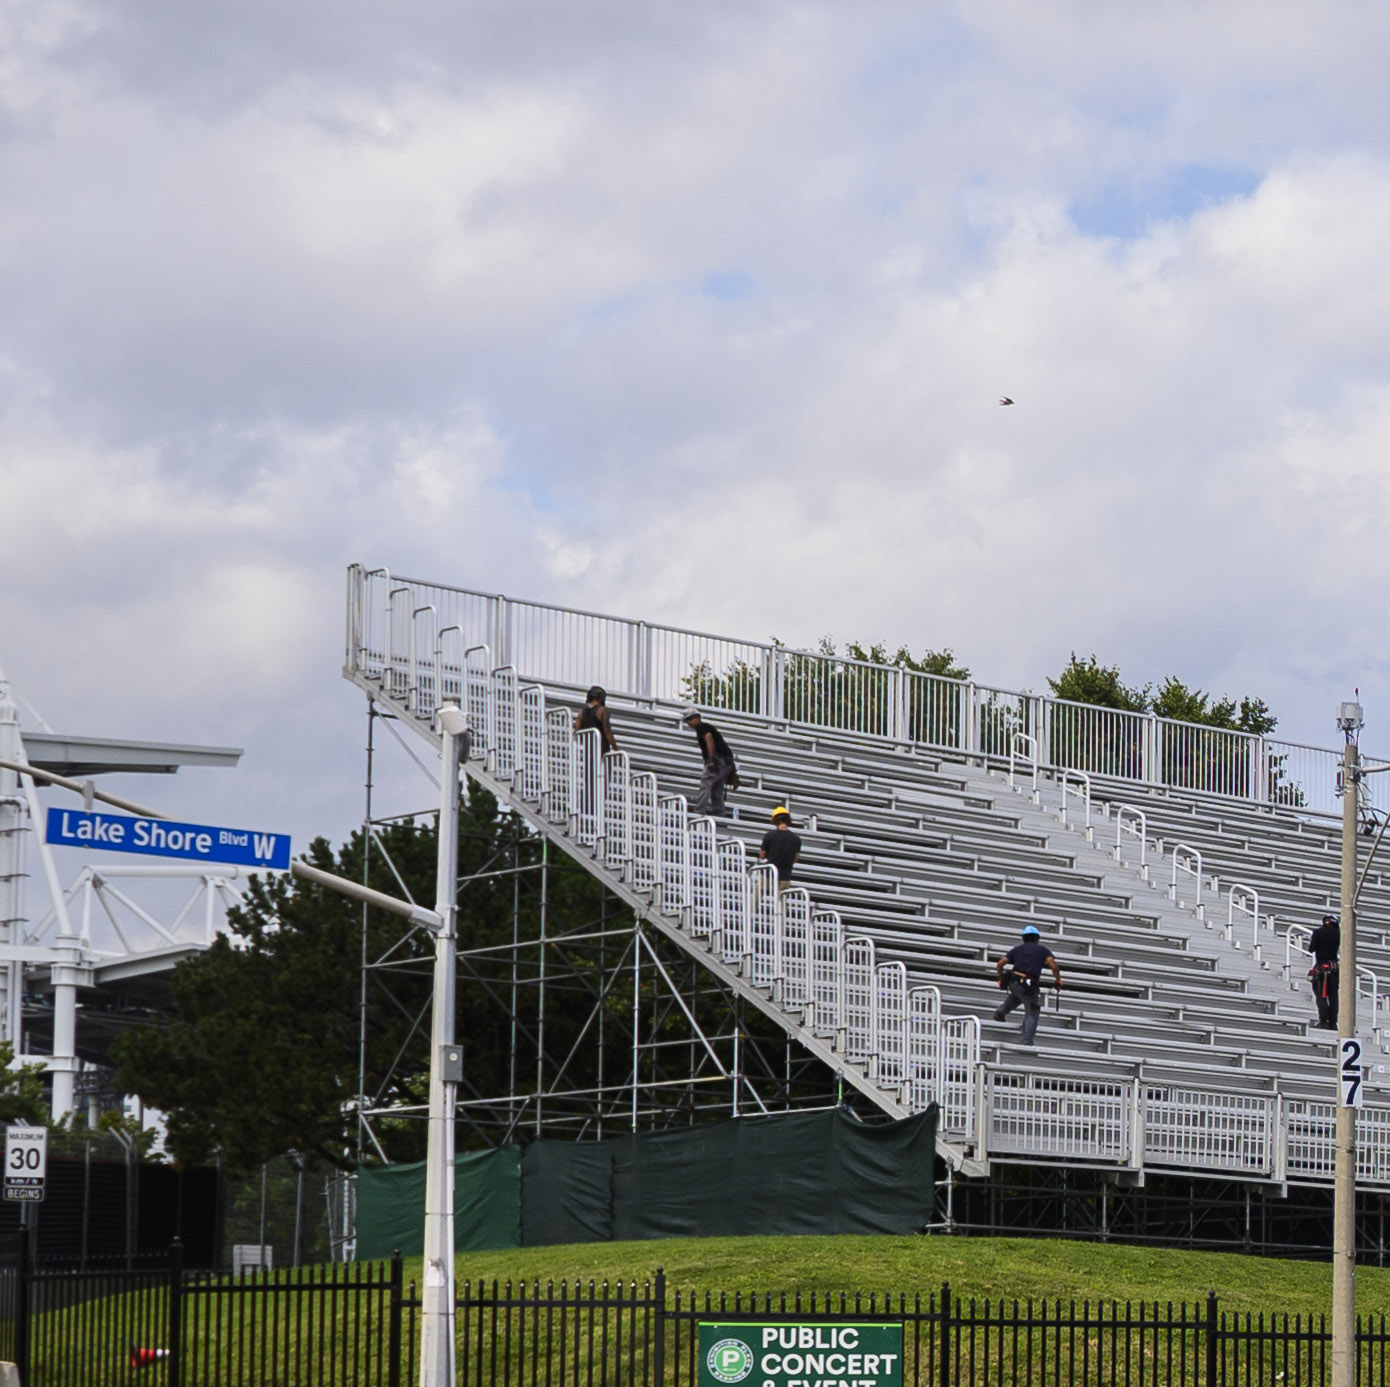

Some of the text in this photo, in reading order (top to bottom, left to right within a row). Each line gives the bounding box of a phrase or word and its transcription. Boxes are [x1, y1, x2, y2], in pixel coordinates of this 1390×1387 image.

[61, 812, 276, 860] Lake Shore Blvd W
[10, 1147, 40, 1170] 30
[7, 1188, 40, 1199] BEGINS
[762, 1327, 859, 1349] PUBLIC
[761, 1353, 898, 1375] CONCERT
